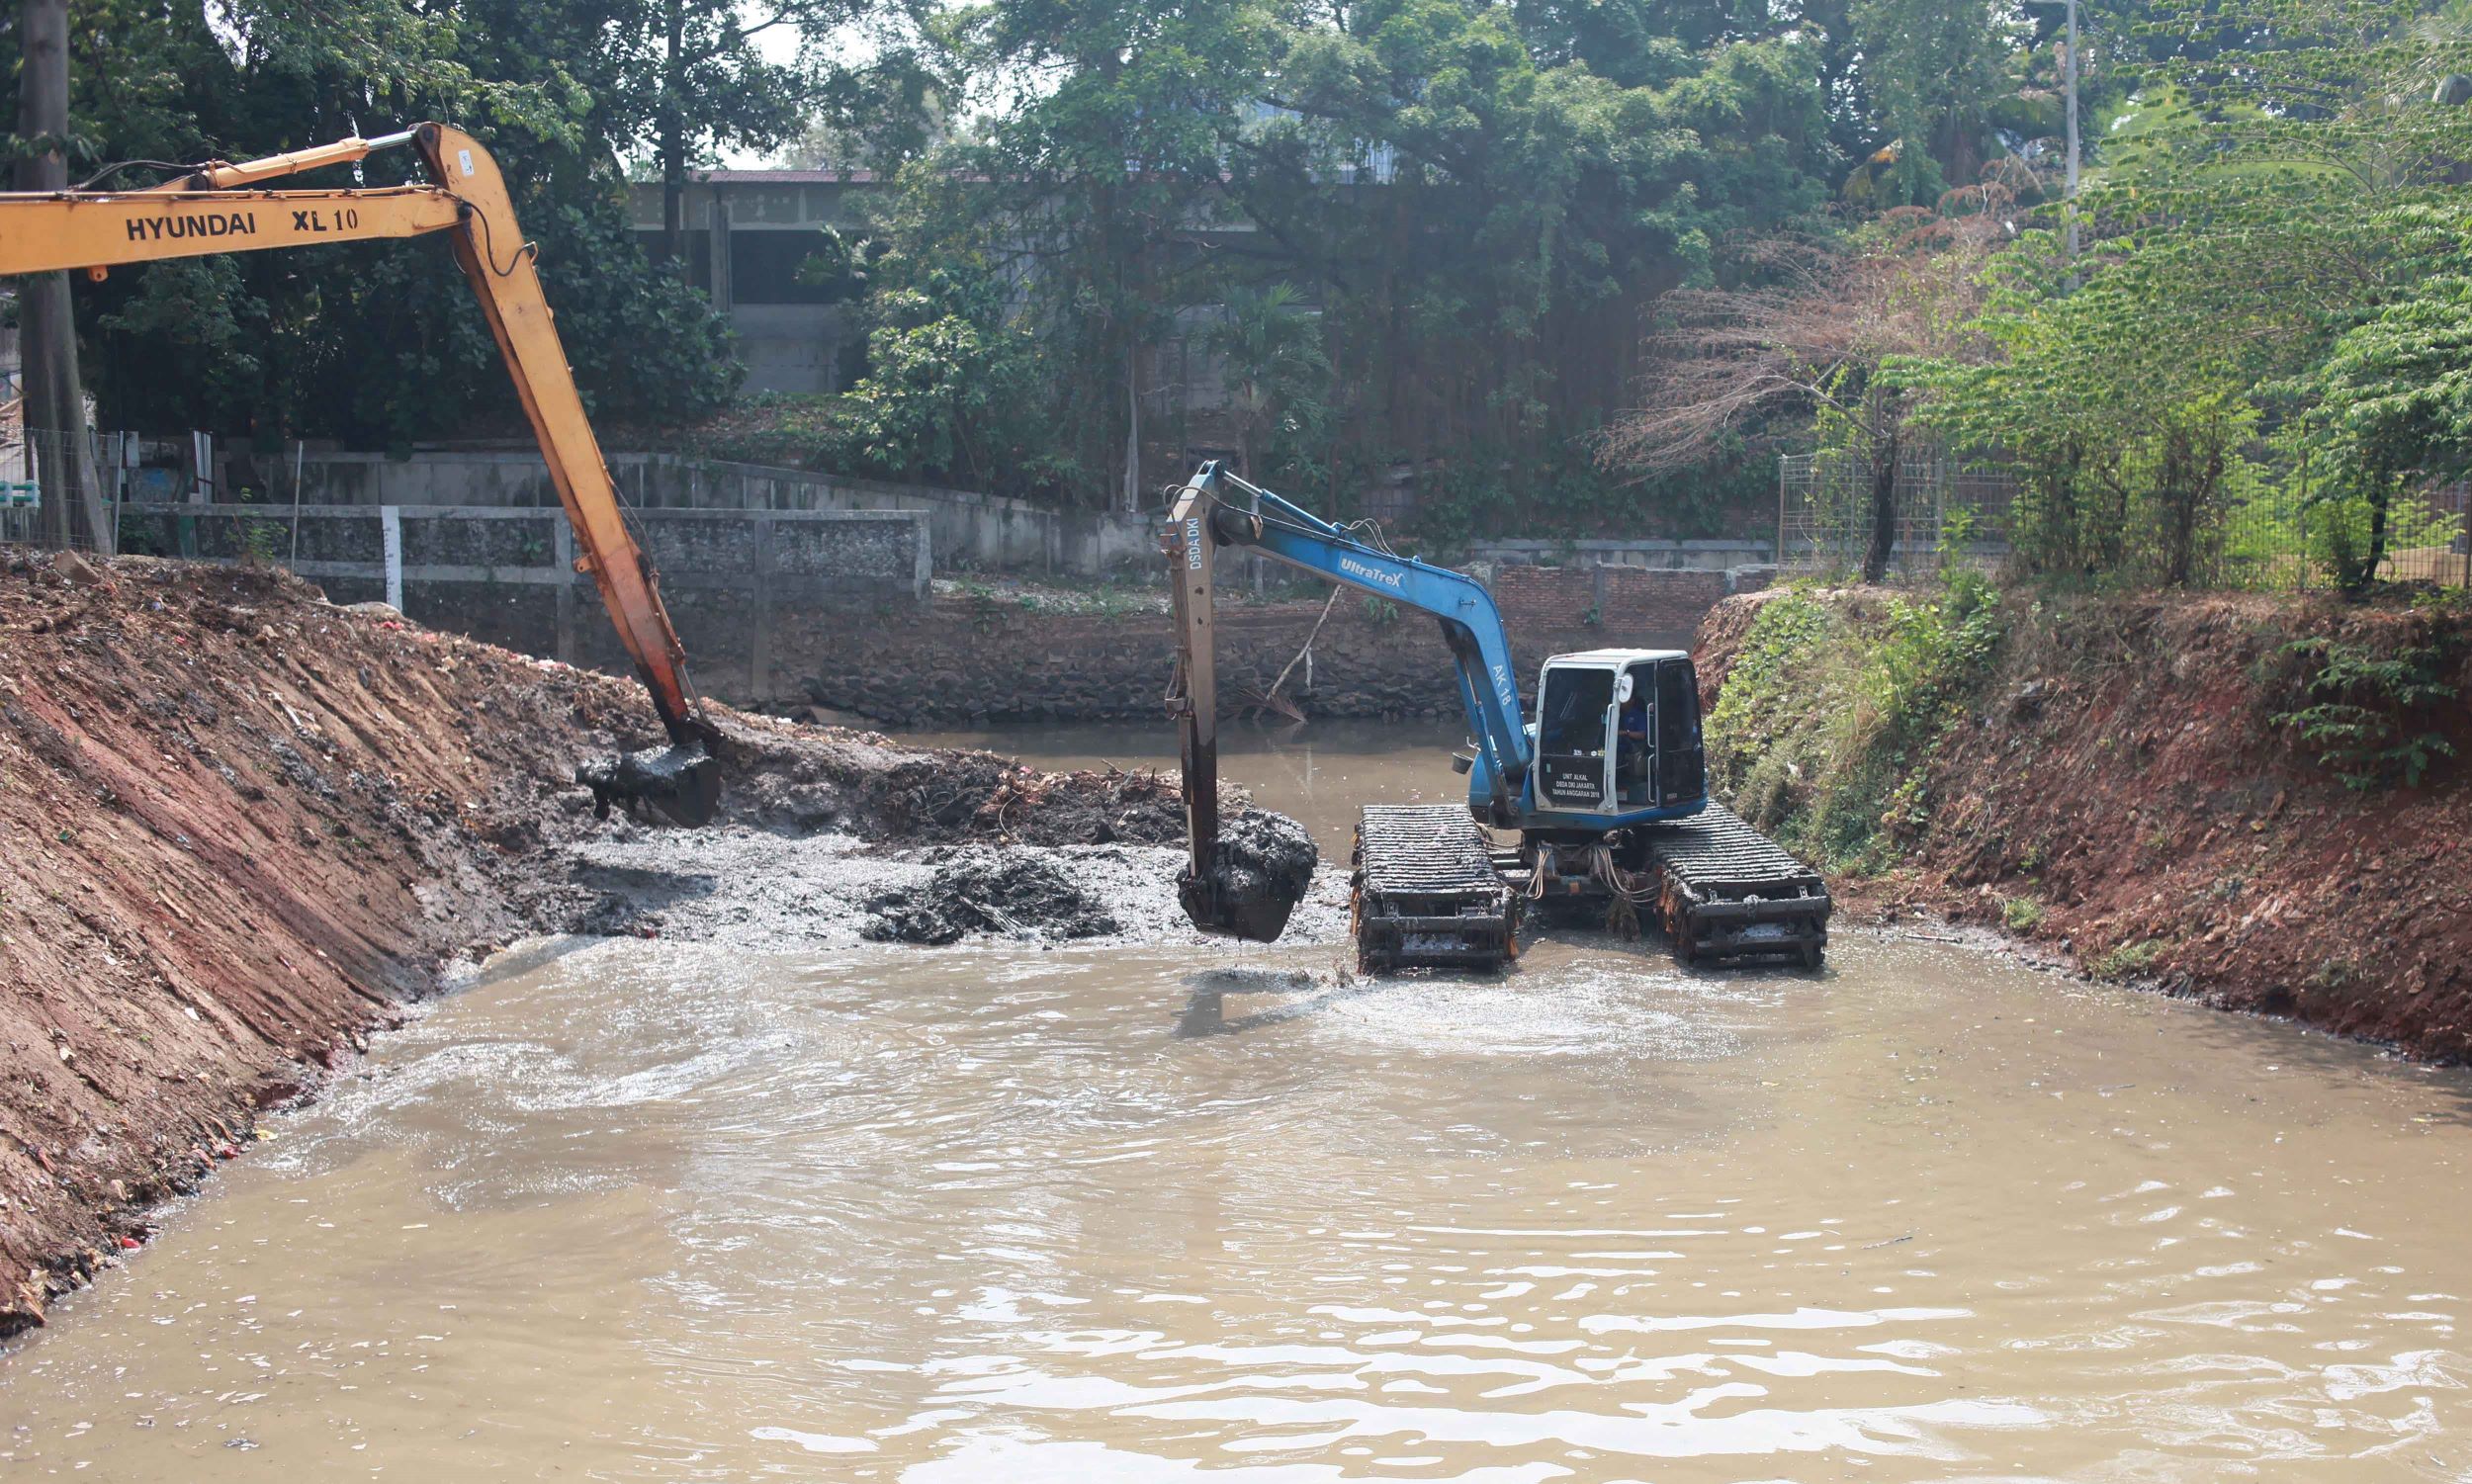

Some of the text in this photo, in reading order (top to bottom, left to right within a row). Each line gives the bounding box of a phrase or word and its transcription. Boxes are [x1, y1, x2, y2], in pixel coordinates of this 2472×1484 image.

[126, 209, 359, 240] HYUNDAI XL 10
[1186, 517, 1202, 569] DSDA DKI
[1341, 558, 1402, 588] UltraTreX
[1493, 664, 1512, 706] AK 18
